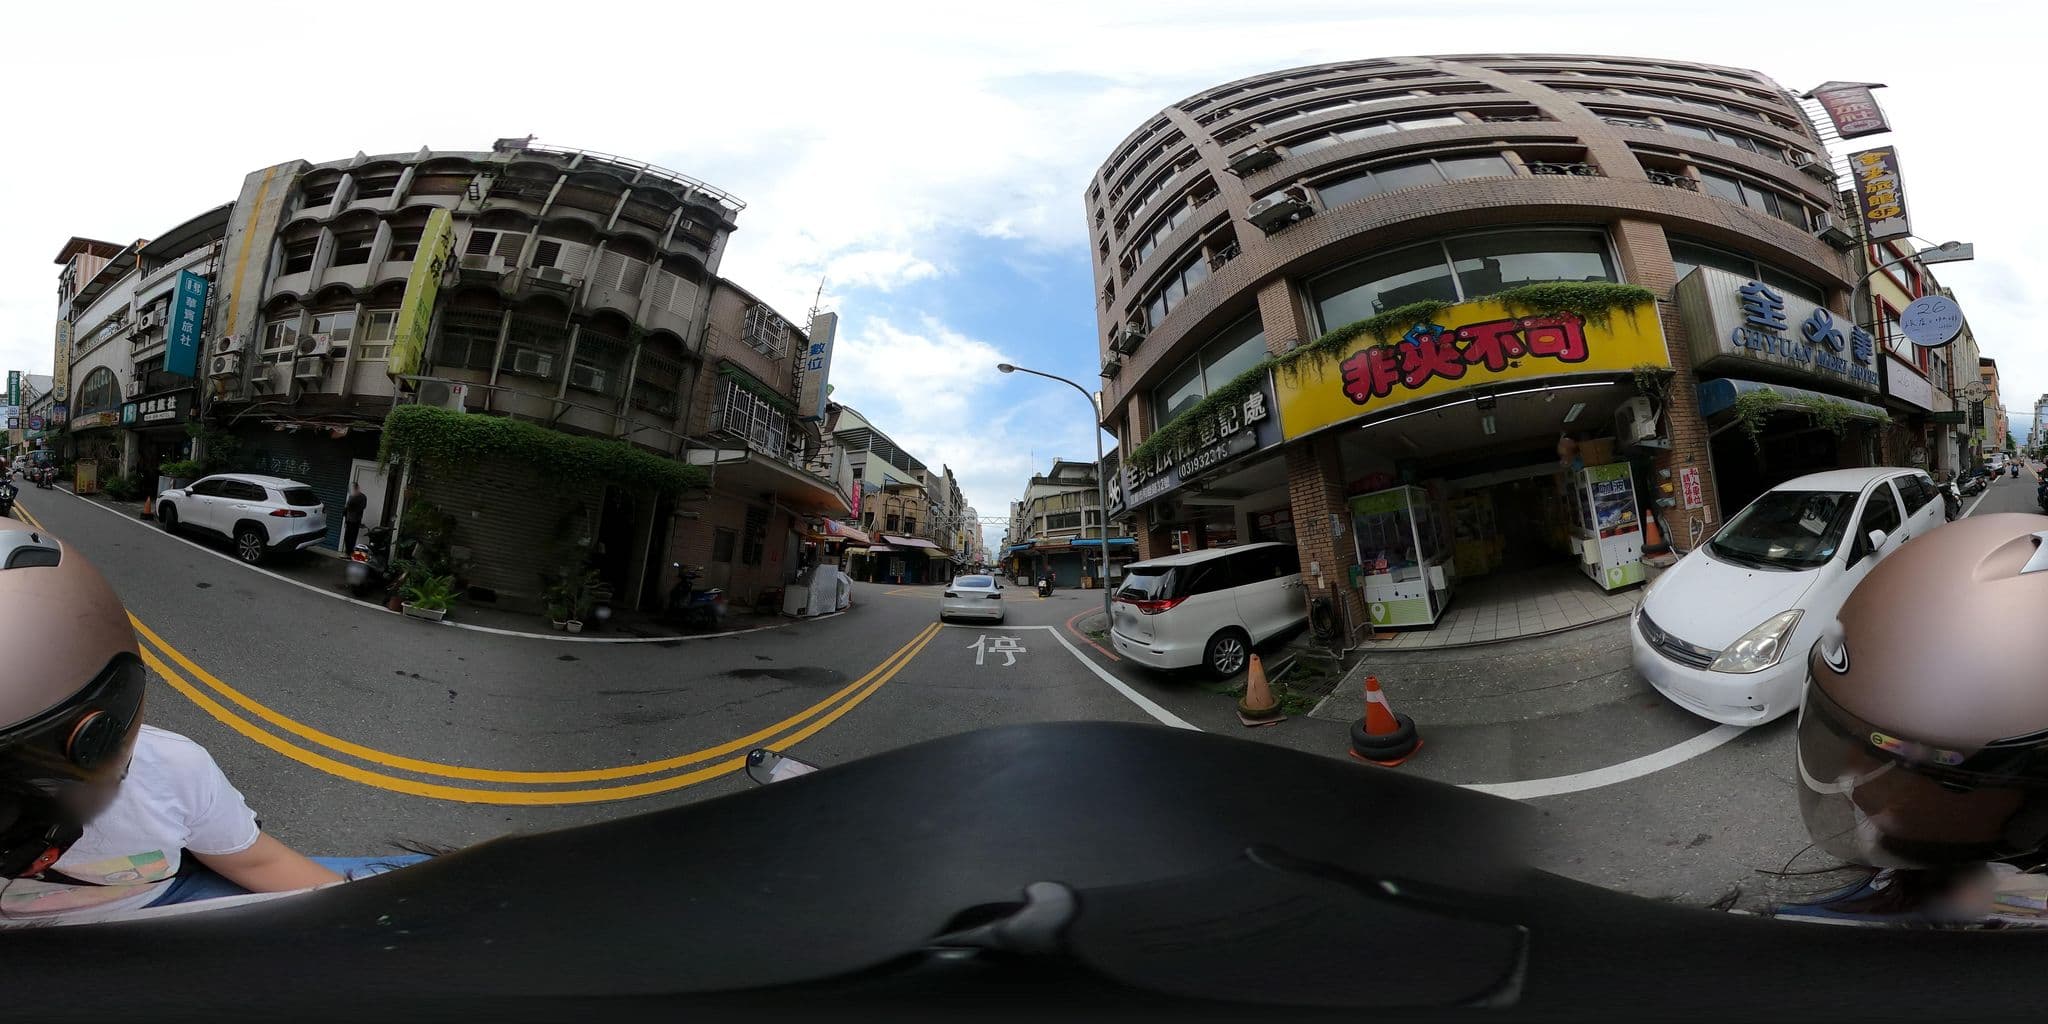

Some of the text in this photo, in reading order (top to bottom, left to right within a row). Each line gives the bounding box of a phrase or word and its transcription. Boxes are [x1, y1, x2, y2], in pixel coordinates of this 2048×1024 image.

[1874, 207, 1893, 217] 3F
[1740, 281, 1873, 364] 全 美
[1917, 301, 1946, 315] 26
[807, 342, 826, 371] 數位
[1339, 311, 1590, 405] 非夾不可
[1732, 326, 1813, 364] CHYUAN
[967, 635, 1027, 666] 停
